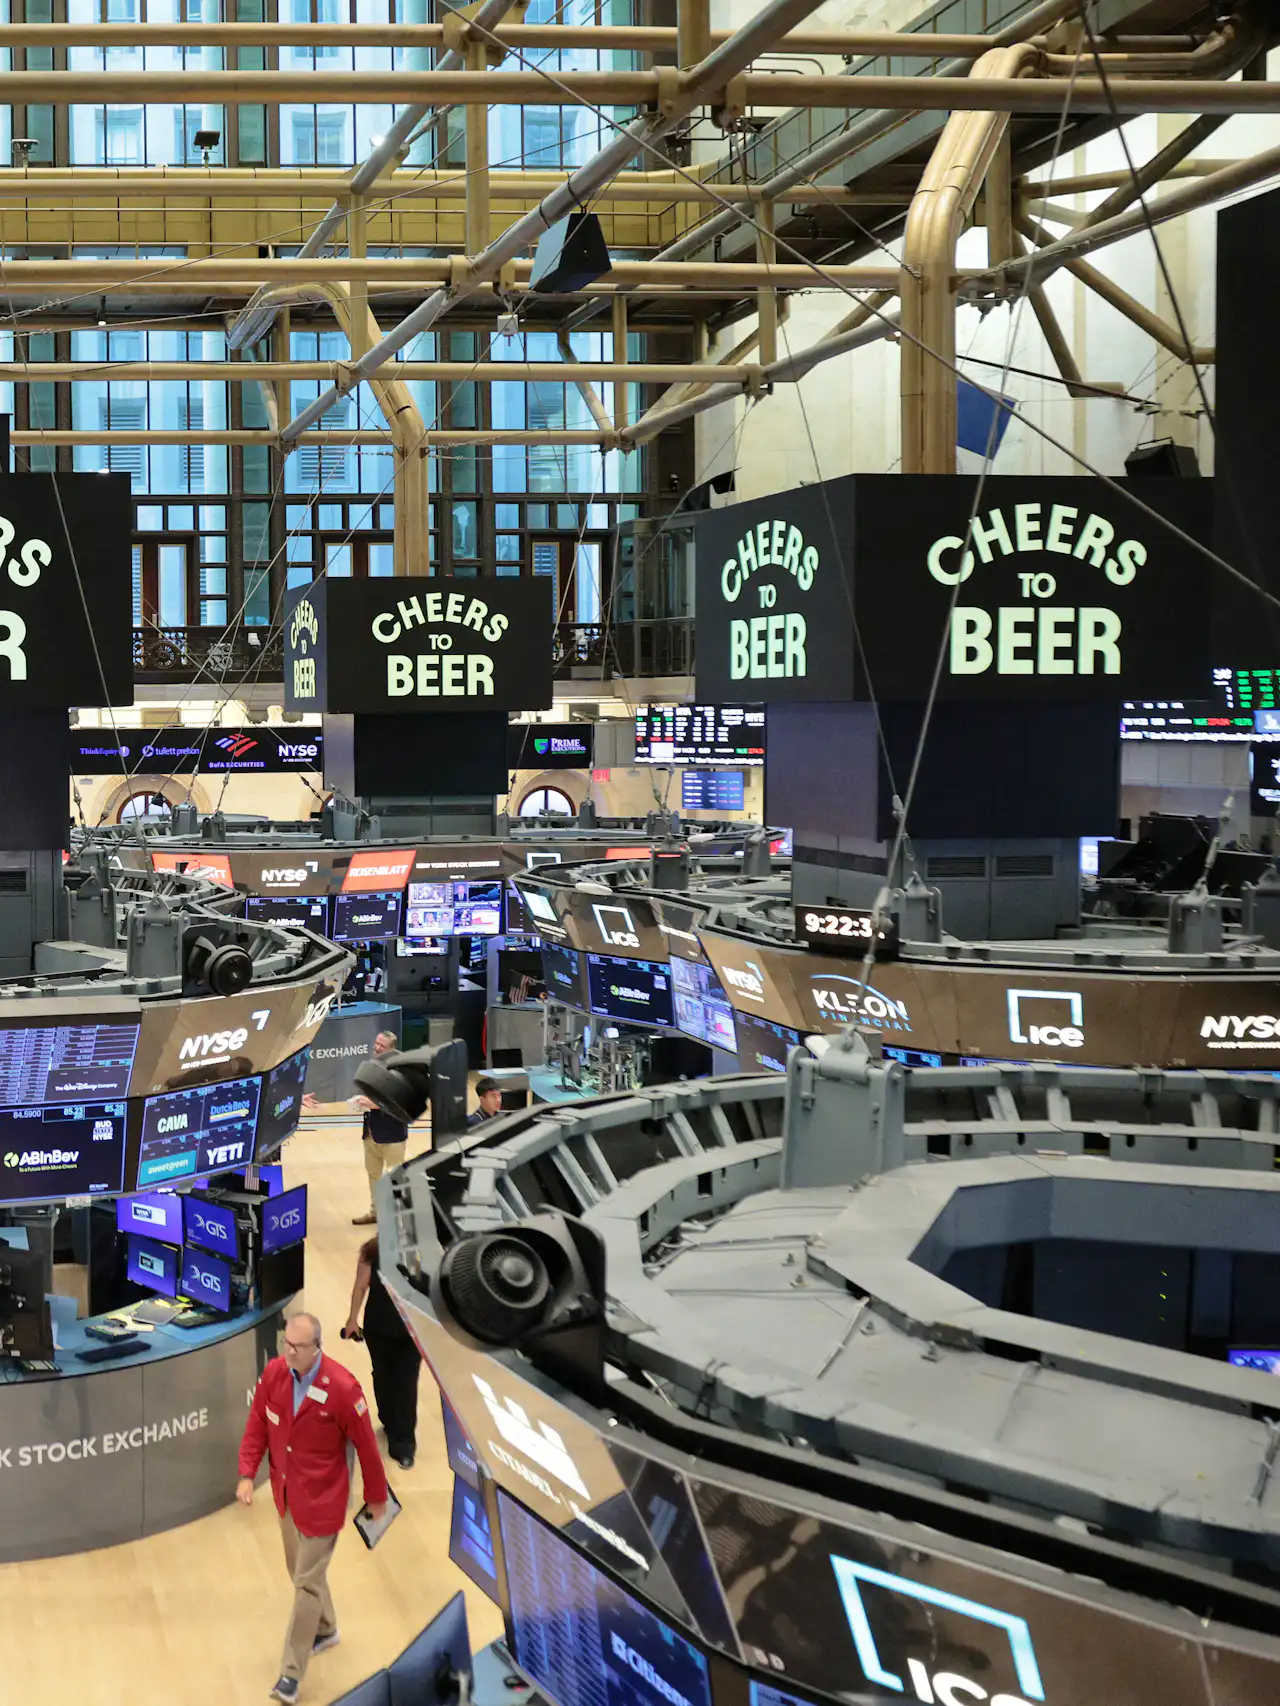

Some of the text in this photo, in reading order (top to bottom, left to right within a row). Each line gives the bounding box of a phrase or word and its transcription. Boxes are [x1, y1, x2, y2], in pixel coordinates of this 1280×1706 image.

[927, 502, 1148, 587] CHEERS
[722, 519, 819, 603] CHEERS
[758, 583, 777, 608] TO
[1018, 572, 1057, 599] TO
[290, 599, 319, 650] CHEERS
[371, 592, 509, 643] CHEERS
[429, 633, 453, 650] TO
[730, 612, 807, 680] BEER
[949, 606, 1122, 675] BEER
[293, 657, 316, 699] BEER
[387, 654, 495, 697] BEER
[551, 738, 580, 747] PRIME
[349, 865, 409, 878] ROSENBLATT
[805, 913, 885, 939] 9:22:3
[820, 1010, 913, 1032] FINNCIAL
[316, 1044, 369, 1060] EXCHANGE
[13, 1110, 41, 1119] 84.5900
[64, 1107, 83, 1116] 85.23
[95, 1121, 112, 1129] BUD
[157, 1113, 189, 1134] CAVA
[93, 1133, 113, 1141] NYSE
[19, 1149, 79, 1166] ABInBev
[207, 1142, 246, 1166] YETI
[148, 1158, 189, 1175] sweetgreen
[280, 1208, 301, 1229] GTS
[205, 1220, 228, 1239] GTS
[200, 1272, 222, 1293] GTS
[18, 1437, 98, 1467] STOCK
[103, 1408, 209, 1455] EXCHANGE
